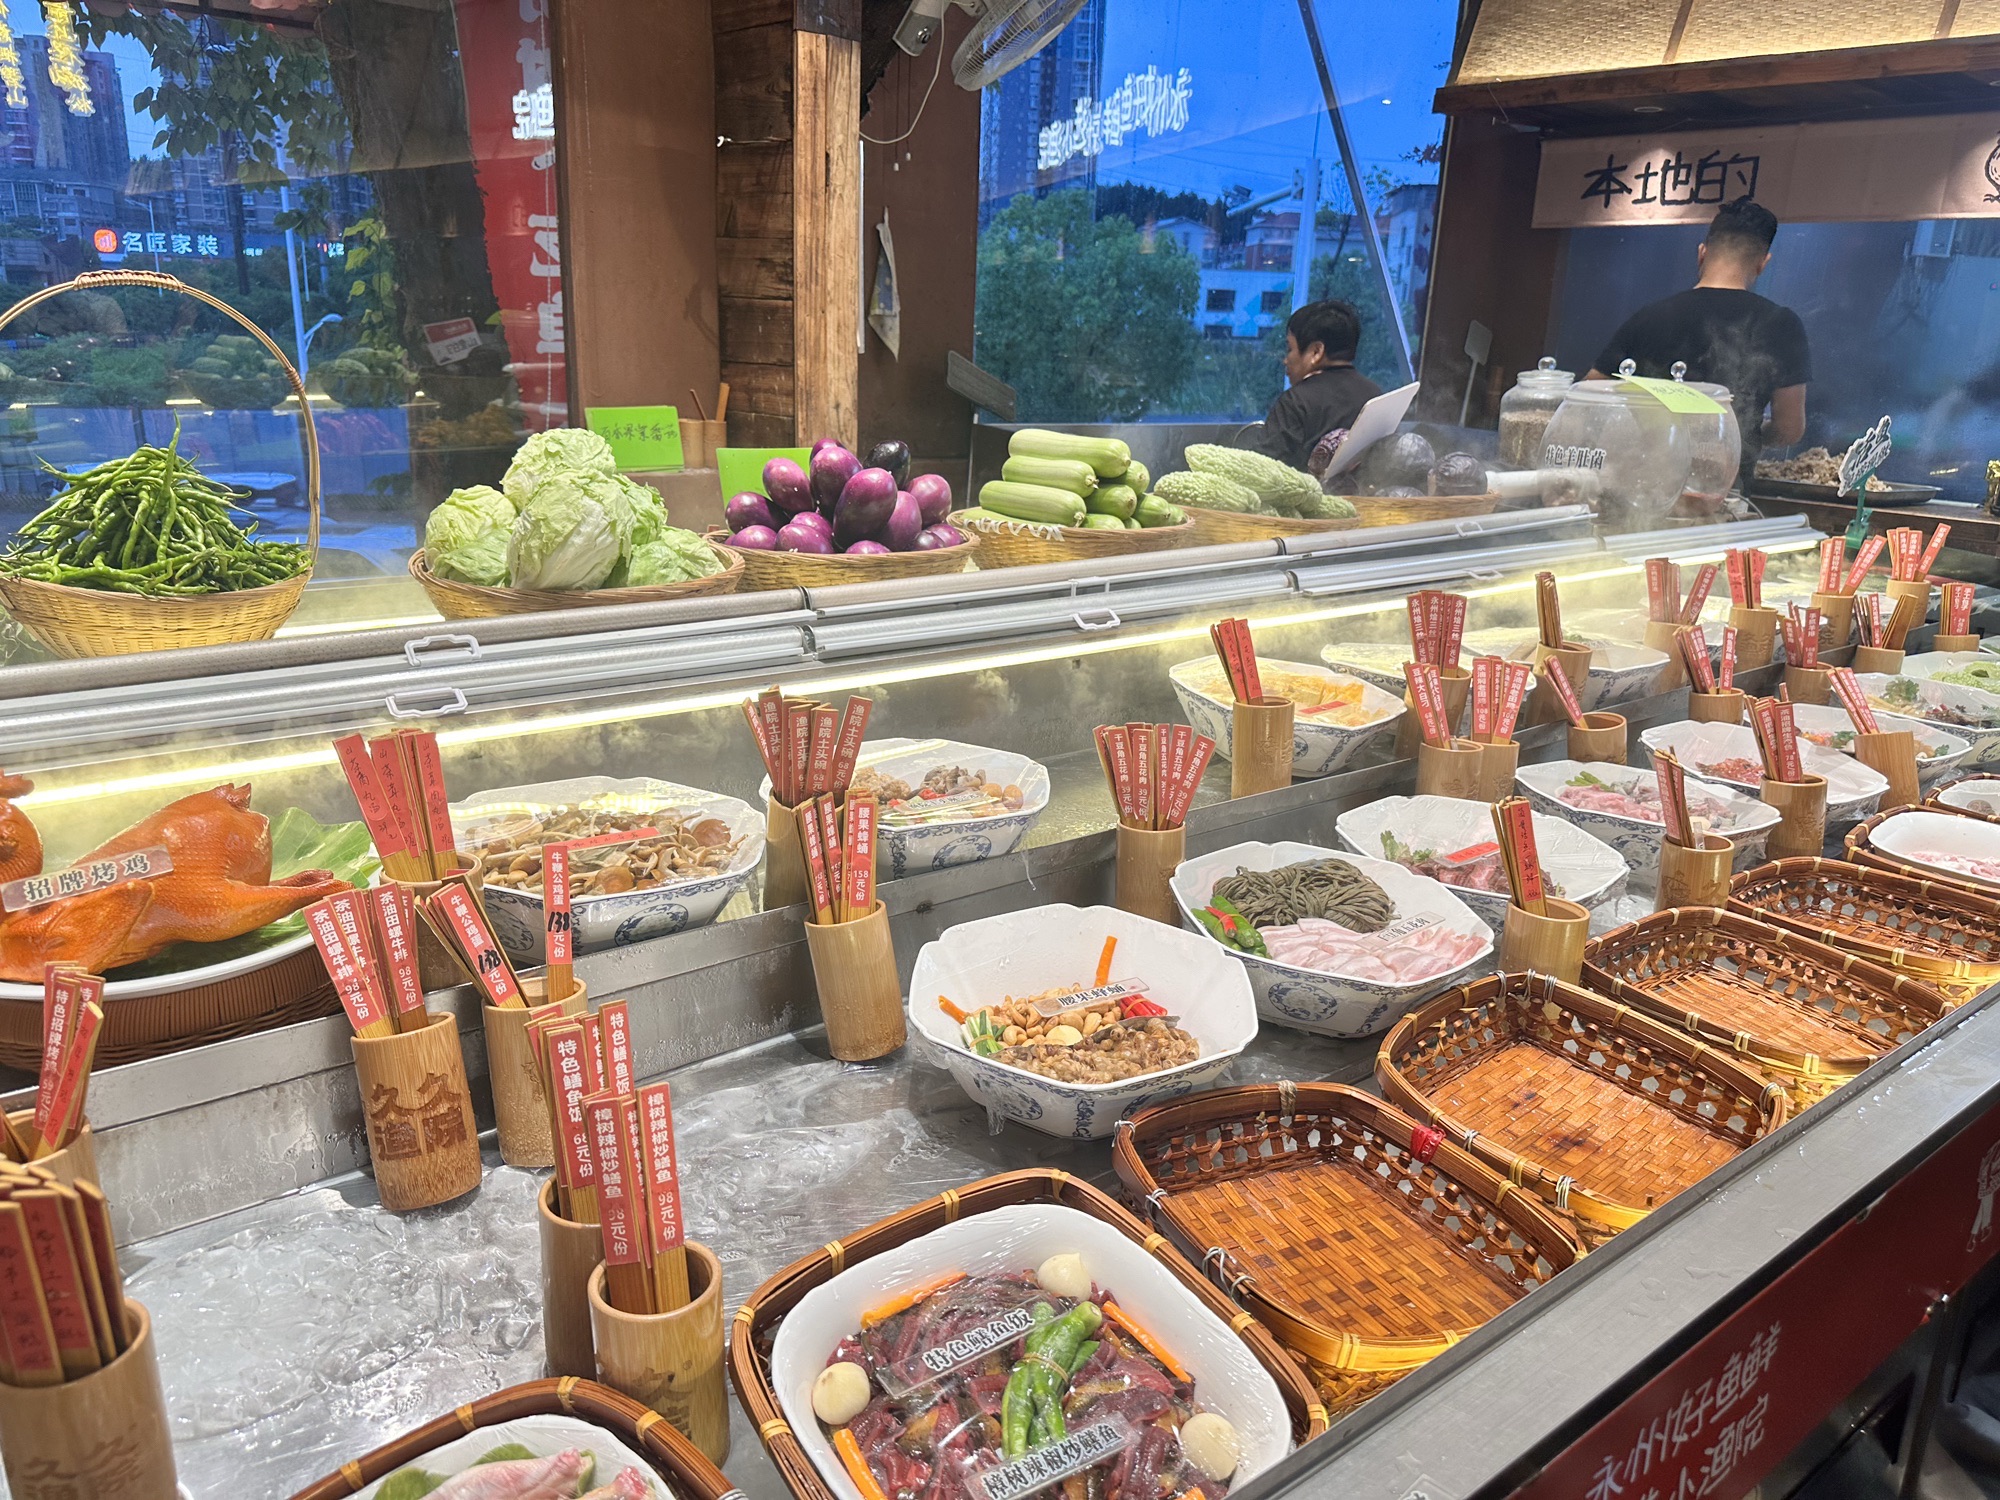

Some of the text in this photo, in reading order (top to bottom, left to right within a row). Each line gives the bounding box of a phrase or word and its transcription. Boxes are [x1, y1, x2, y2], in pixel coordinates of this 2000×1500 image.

[1581, 150, 1760, 209] 本地的
[1544, 445, 1606, 470] 特色羊肚菌
[814, 716, 832, 770] 渔院土头碗
[840, 704, 865, 759] 渔院土头碗
[1114, 733, 1129, 783] 干豆角五花肉
[1172, 731, 1187, 780] 干豆角五花肉
[1138, 735, 1147, 785] 干豆角五花肉
[1182, 741, 1208, 790] 干豆角五花肉
[804, 811, 818, 860] 腰果蜂蛹
[824, 801, 837, 850] 腰果蜂蛹
[856, 807, 871, 856] 腰果蜂蛹
[25, 853, 150, 901] 招牌烤鸡
[551, 852, 564, 906] 牛鞭公鸡蛋
[312, 908, 355, 980] 茶油田螺牛排
[379, 891, 410, 963] 茶油田螺牛排
[451, 895, 484, 948] 牛鞭公鸡蛋
[1058, 983, 1127, 1007] 腰果蜂蛹
[610, 1012, 631, 1096] 特色鳝鱼饭
[557, 1040, 584, 1123] 特色鳝鱼饭
[594, 1108, 624, 1199] 樟树辣椒炒鳝鱼
[647, 1092, 673, 1184] 樟树辣椒炒鳝鱼
[923, 1308, 1034, 1371] 特色鳝鱼饭
[1586, 1320, 1781, 1500] 永州好鱼鲜
[983, 1423, 1123, 1500] 樟树辣椒炒鳝鱼
[1641, 1393, 1769, 1500] 小渔院
